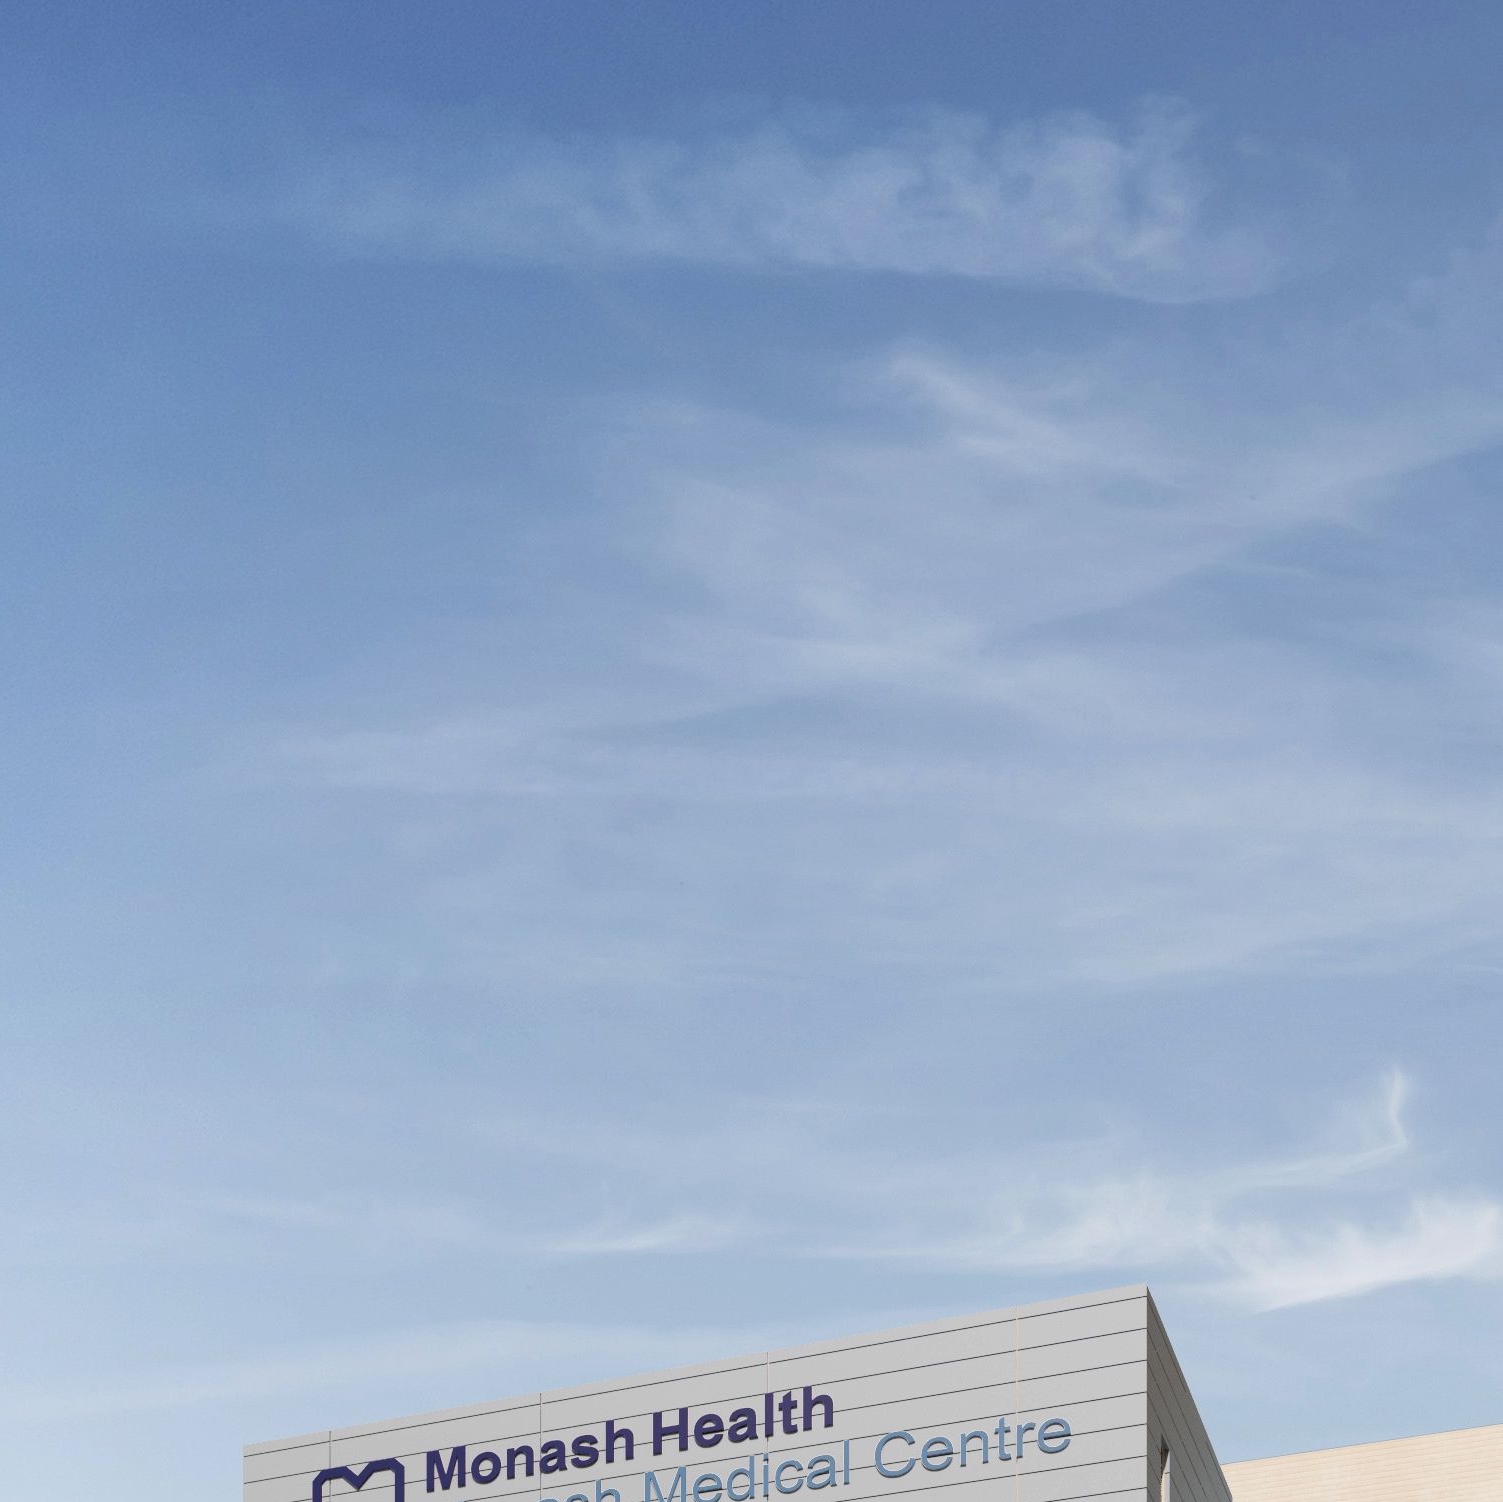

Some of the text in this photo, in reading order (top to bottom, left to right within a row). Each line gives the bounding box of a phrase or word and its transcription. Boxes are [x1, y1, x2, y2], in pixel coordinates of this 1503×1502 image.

[425, 1385, 834, 1493] Monash Health
[874, 1416, 1072, 1479] Centre
